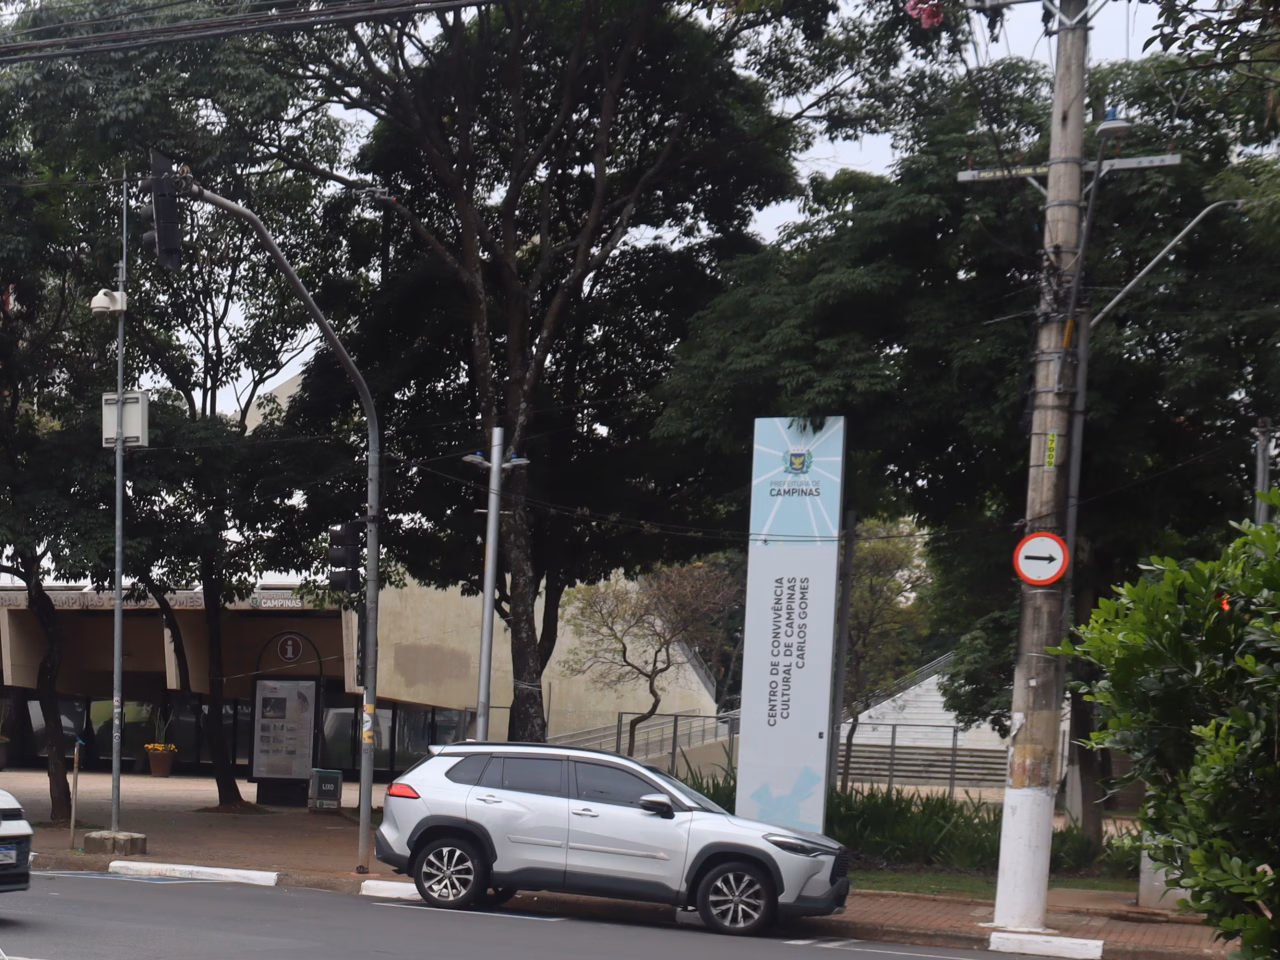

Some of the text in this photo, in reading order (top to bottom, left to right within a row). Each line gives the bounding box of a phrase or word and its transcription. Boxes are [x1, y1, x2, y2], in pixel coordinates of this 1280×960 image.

[812, 480, 821, 488] DE
[769, 488, 821, 497] CAMPINAS
[51, 596, 105, 609] AMPINAS
[166, 596, 203, 609] OMES
[261, 599, 302, 608] CAMPINAS
[795, 577, 810, 669] CARLOS GOMES
[767, 576, 784, 727] CENTRO DE CONVIVÊNCIA
[780, 577, 797, 720] CULTURAL DE CAMPINAS
